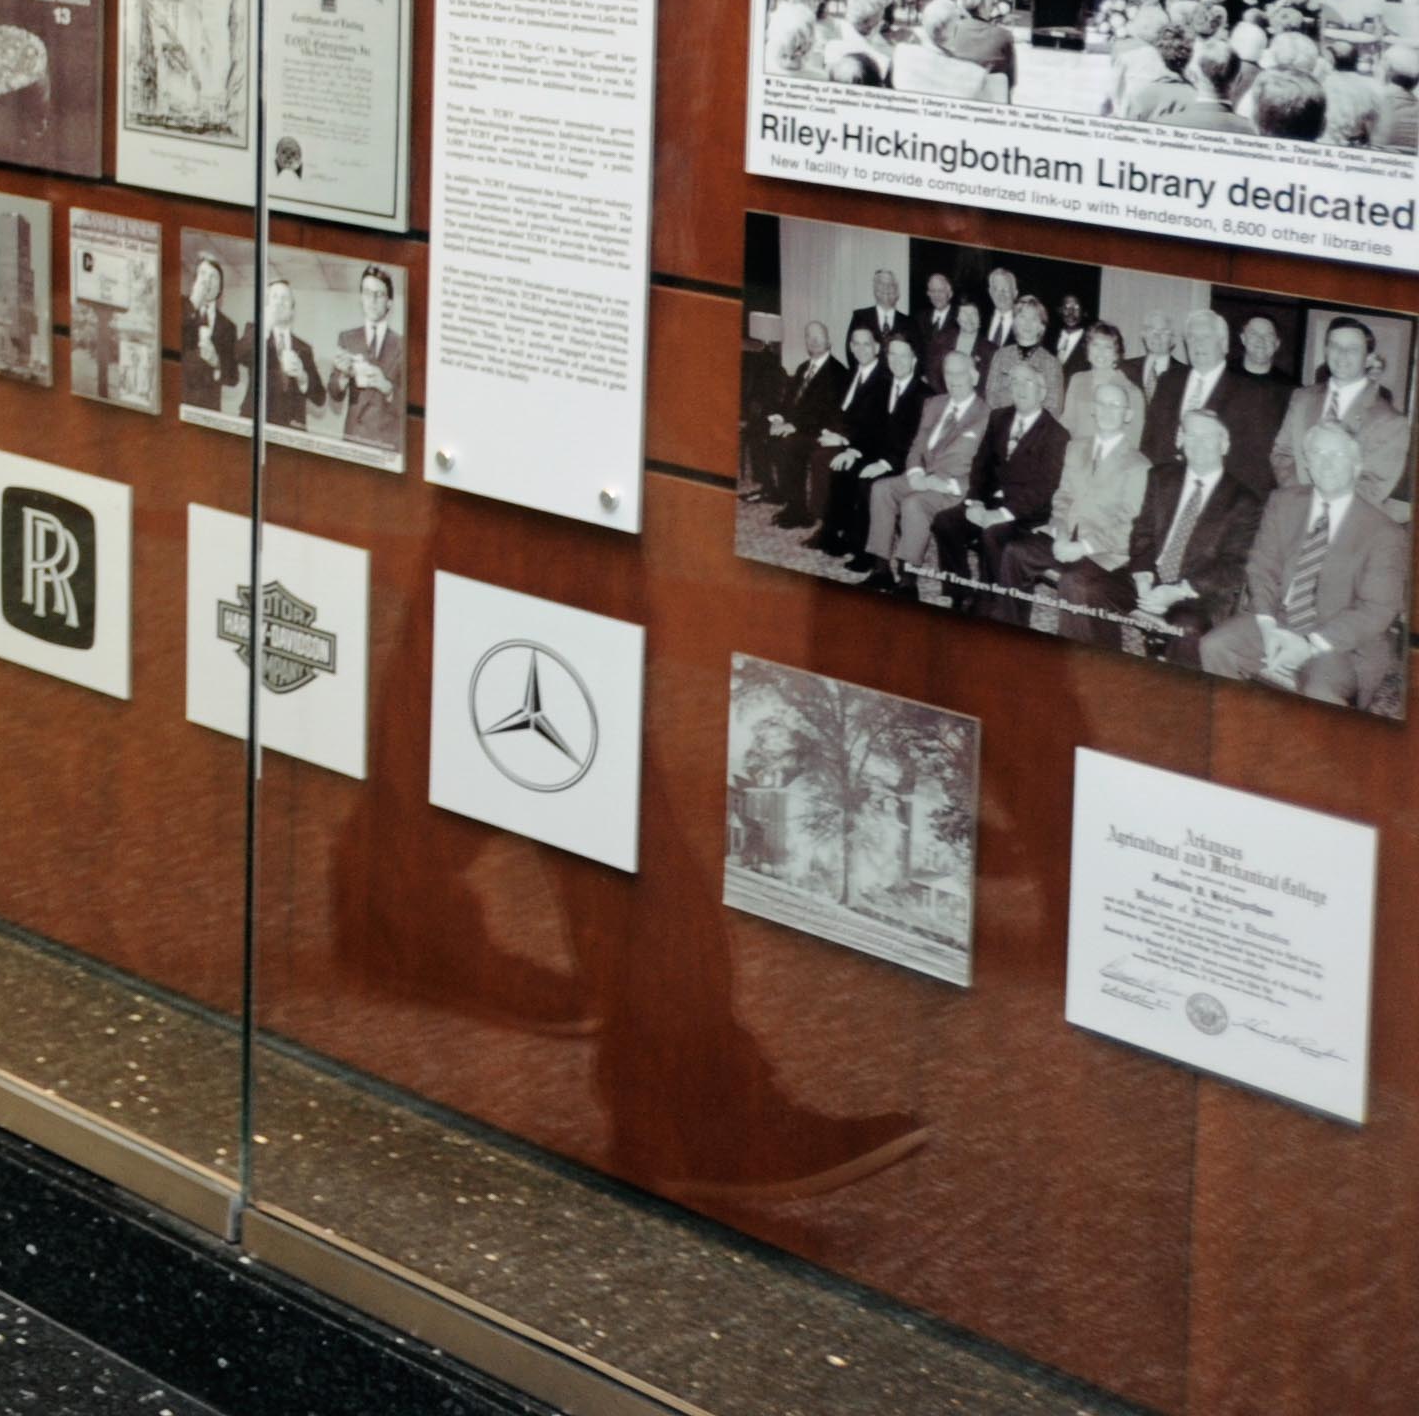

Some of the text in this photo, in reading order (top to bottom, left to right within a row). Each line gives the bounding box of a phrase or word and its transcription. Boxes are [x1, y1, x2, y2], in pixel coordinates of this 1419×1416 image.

[761, 113, 1416, 231] Riley-Hickingbotham Library dedicated
[770, 153, 800, 170] New
[805, 158, 850, 180] facility
[853, 164, 868, 180] to
[871, 168, 923, 188] provide
[927, 177, 1027, 203] computerized
[1030, 188, 1082, 213] link-up
[1087, 200, 1120, 216] with
[1125, 204, 1218, 233] Henderson,
[1271, 227, 1316, 246] other
[1322, 234, 1394, 258] libraries
[261, 593, 307, 625] OTOR
[1105, 823, 1328, 907] Agricultural and Mechanical College
[1184, 827, 1244, 862] Arkansas
